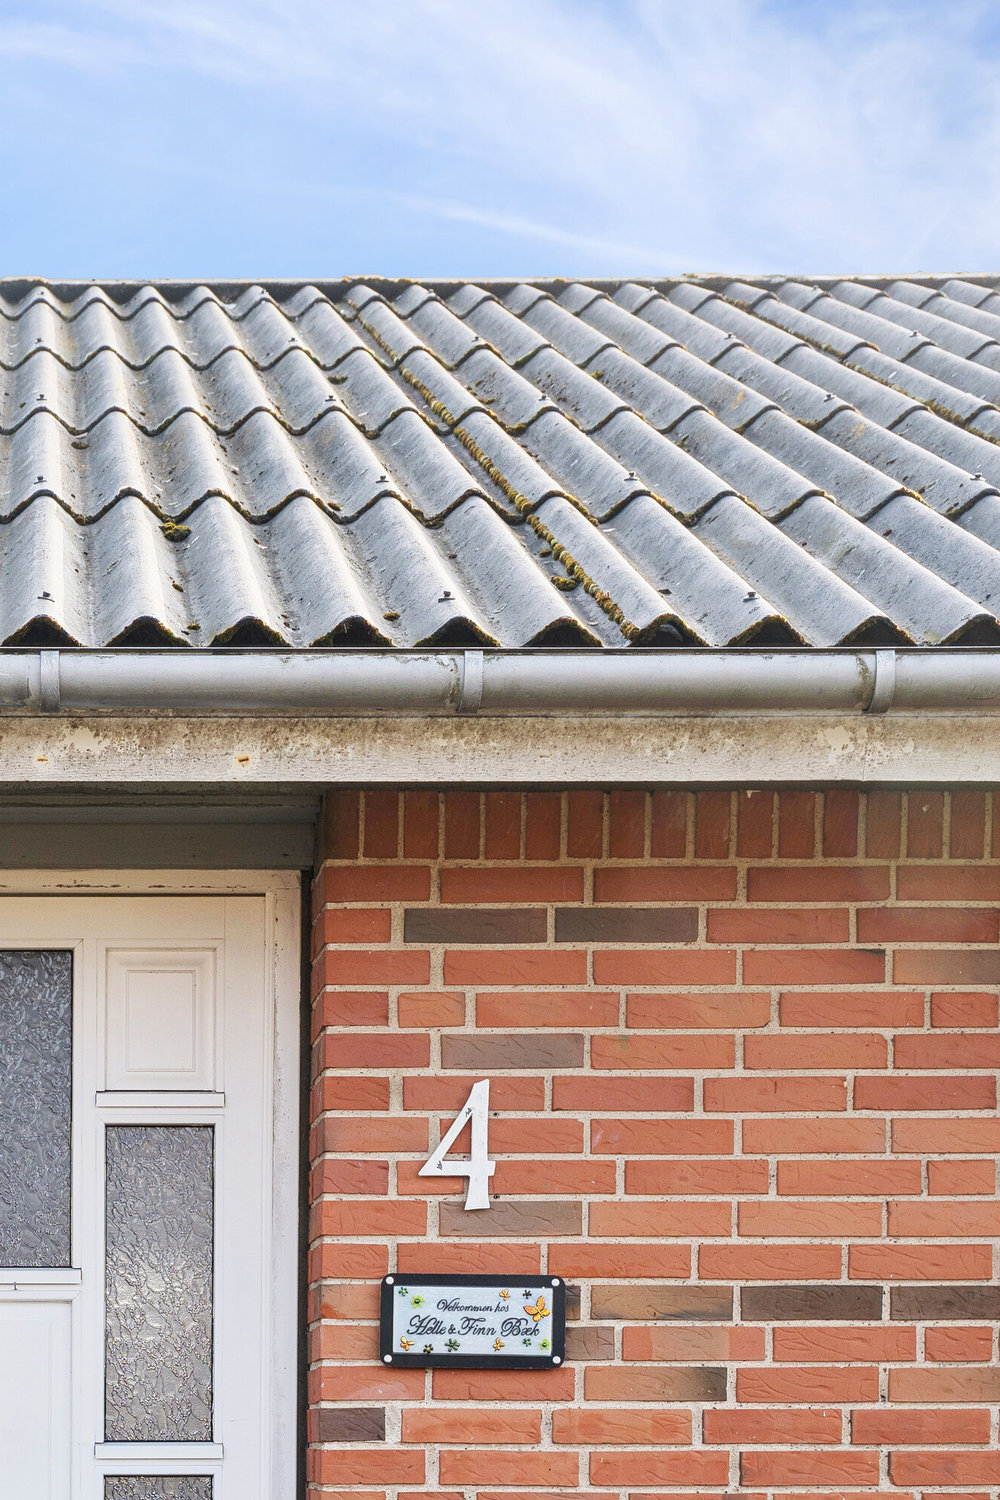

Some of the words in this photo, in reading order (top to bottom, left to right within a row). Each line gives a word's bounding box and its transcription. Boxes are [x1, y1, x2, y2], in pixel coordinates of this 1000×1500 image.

[418, 1078, 496, 1210] 4
[436, 1297, 493, 1312] Velkommen
[494, 1301, 510, 1313] hos
[407, 1314, 447, 1335] Helle
[448, 1323, 458, 1335] &
[458, 1316, 496, 1336] Finn
[500, 1317, 540, 1337] Bæk
